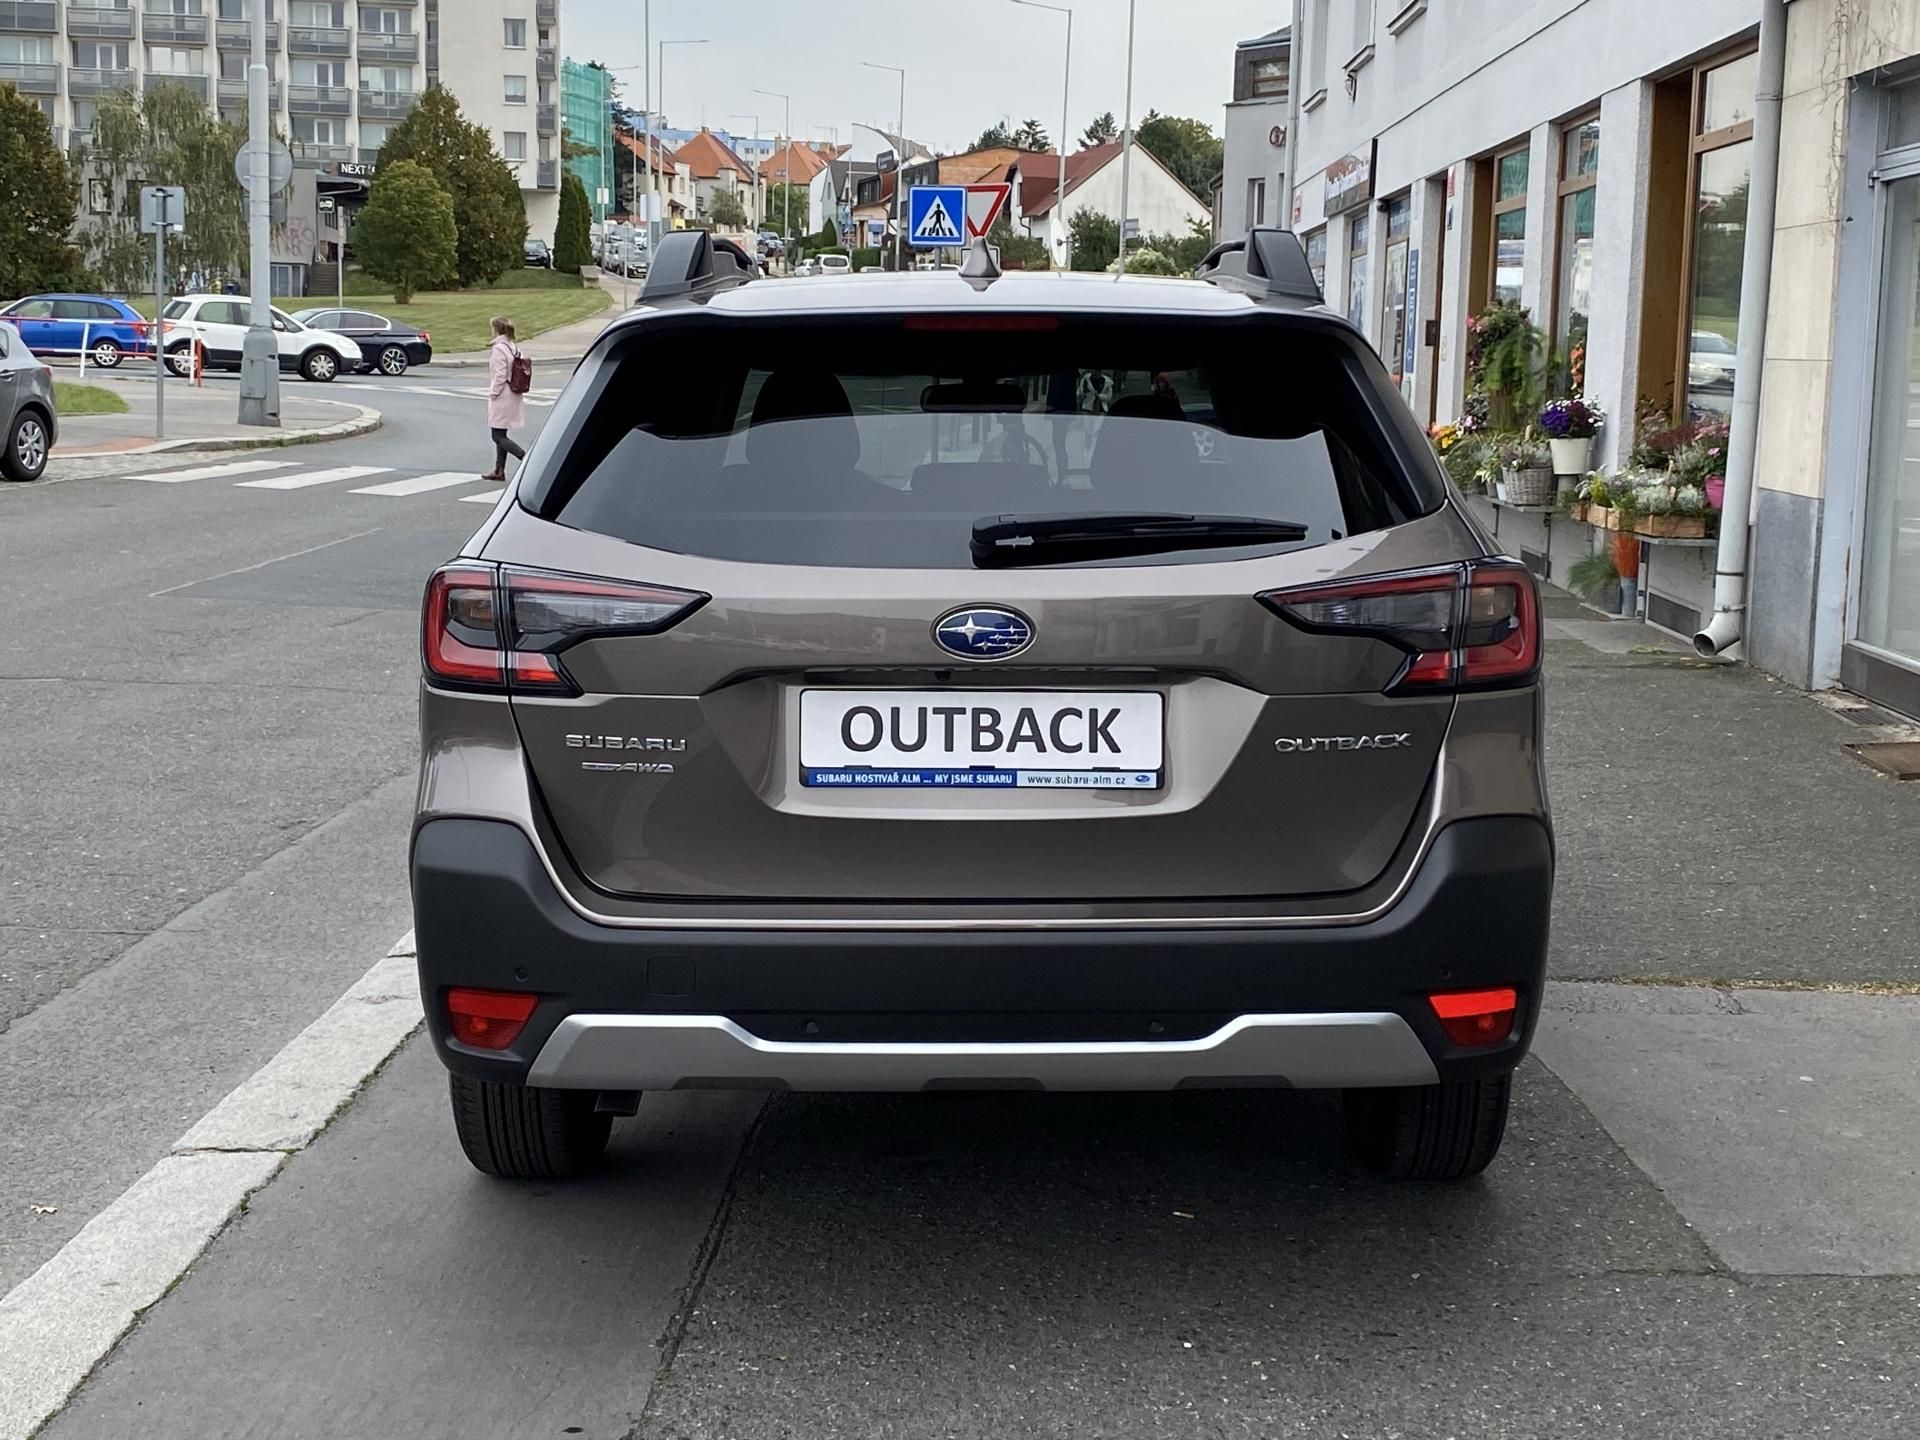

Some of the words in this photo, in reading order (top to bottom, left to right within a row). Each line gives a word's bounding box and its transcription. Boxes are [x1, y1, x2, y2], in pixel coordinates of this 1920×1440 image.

[341, 163, 366, 175] NEXT
[841, 705, 1122, 754] OUTBACK
[565, 734, 686, 752] SUBARU
[1274, 732, 1412, 753] OUTBACK
[816, 773, 852, 784] SUBARU
[855, 771, 899, 784] HOSTIVAŘ
[901, 773, 921, 784] ALM
[934, 773, 949, 784] MY
[951, 774, 974, 785] JSME
[976, 774, 1012, 784] SUBARU
[1027, 774, 1126, 785] www.subaru-alm.cz
